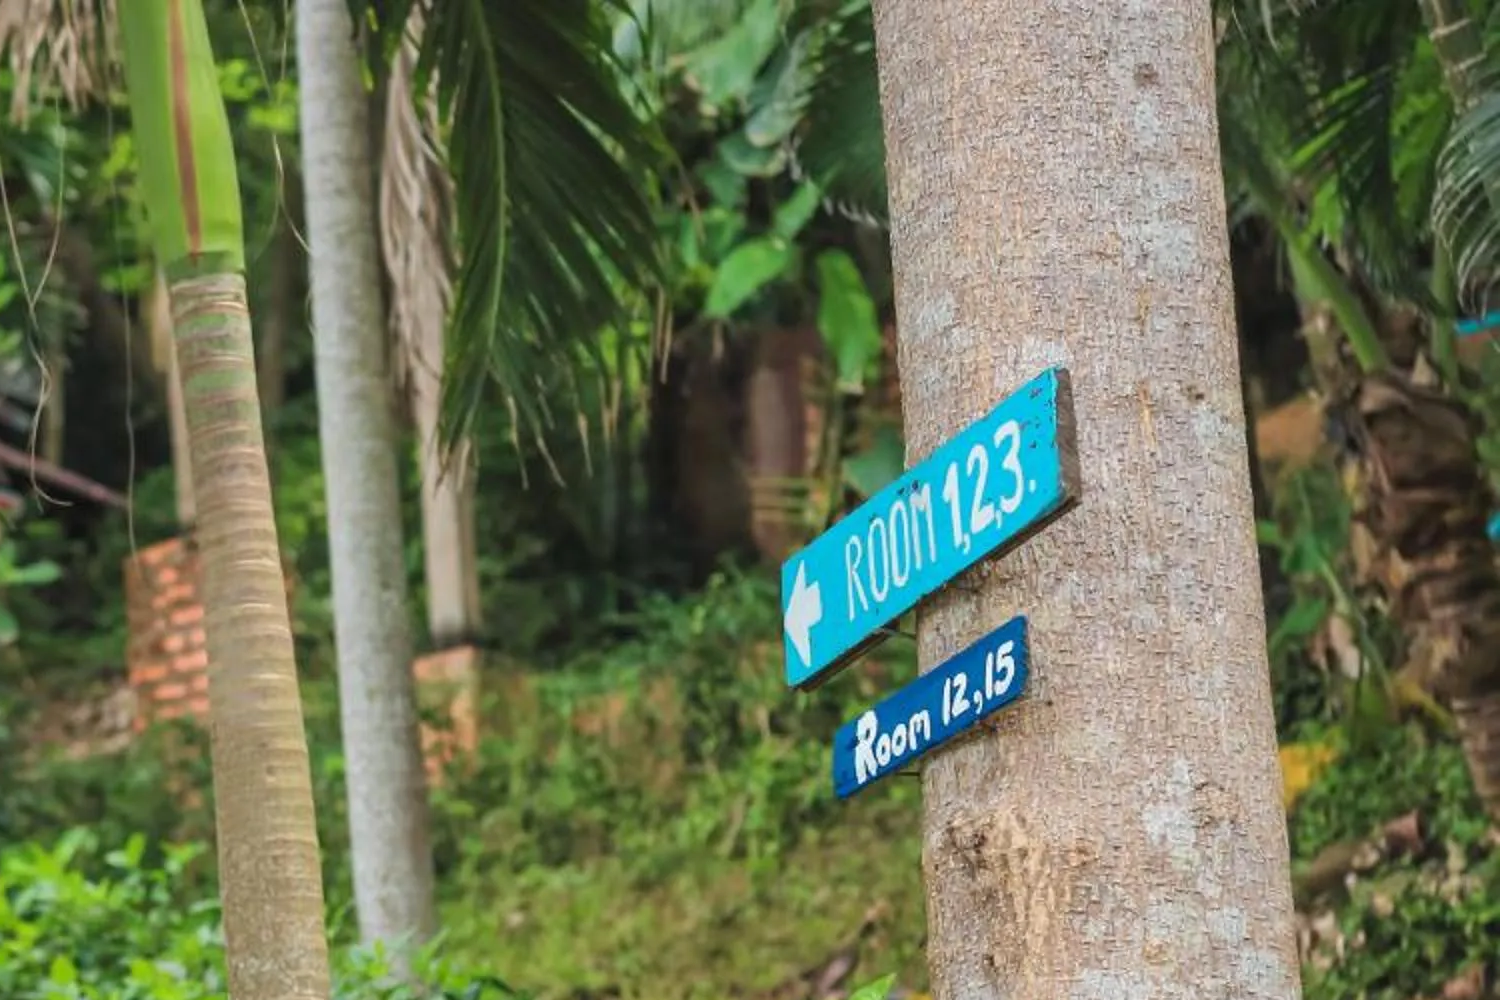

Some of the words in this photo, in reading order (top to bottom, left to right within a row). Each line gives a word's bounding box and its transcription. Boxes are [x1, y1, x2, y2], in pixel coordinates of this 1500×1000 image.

[843, 482, 937, 621] ROOM
[854, 709, 931, 784] Room
[942, 639, 1015, 727] 12,15
